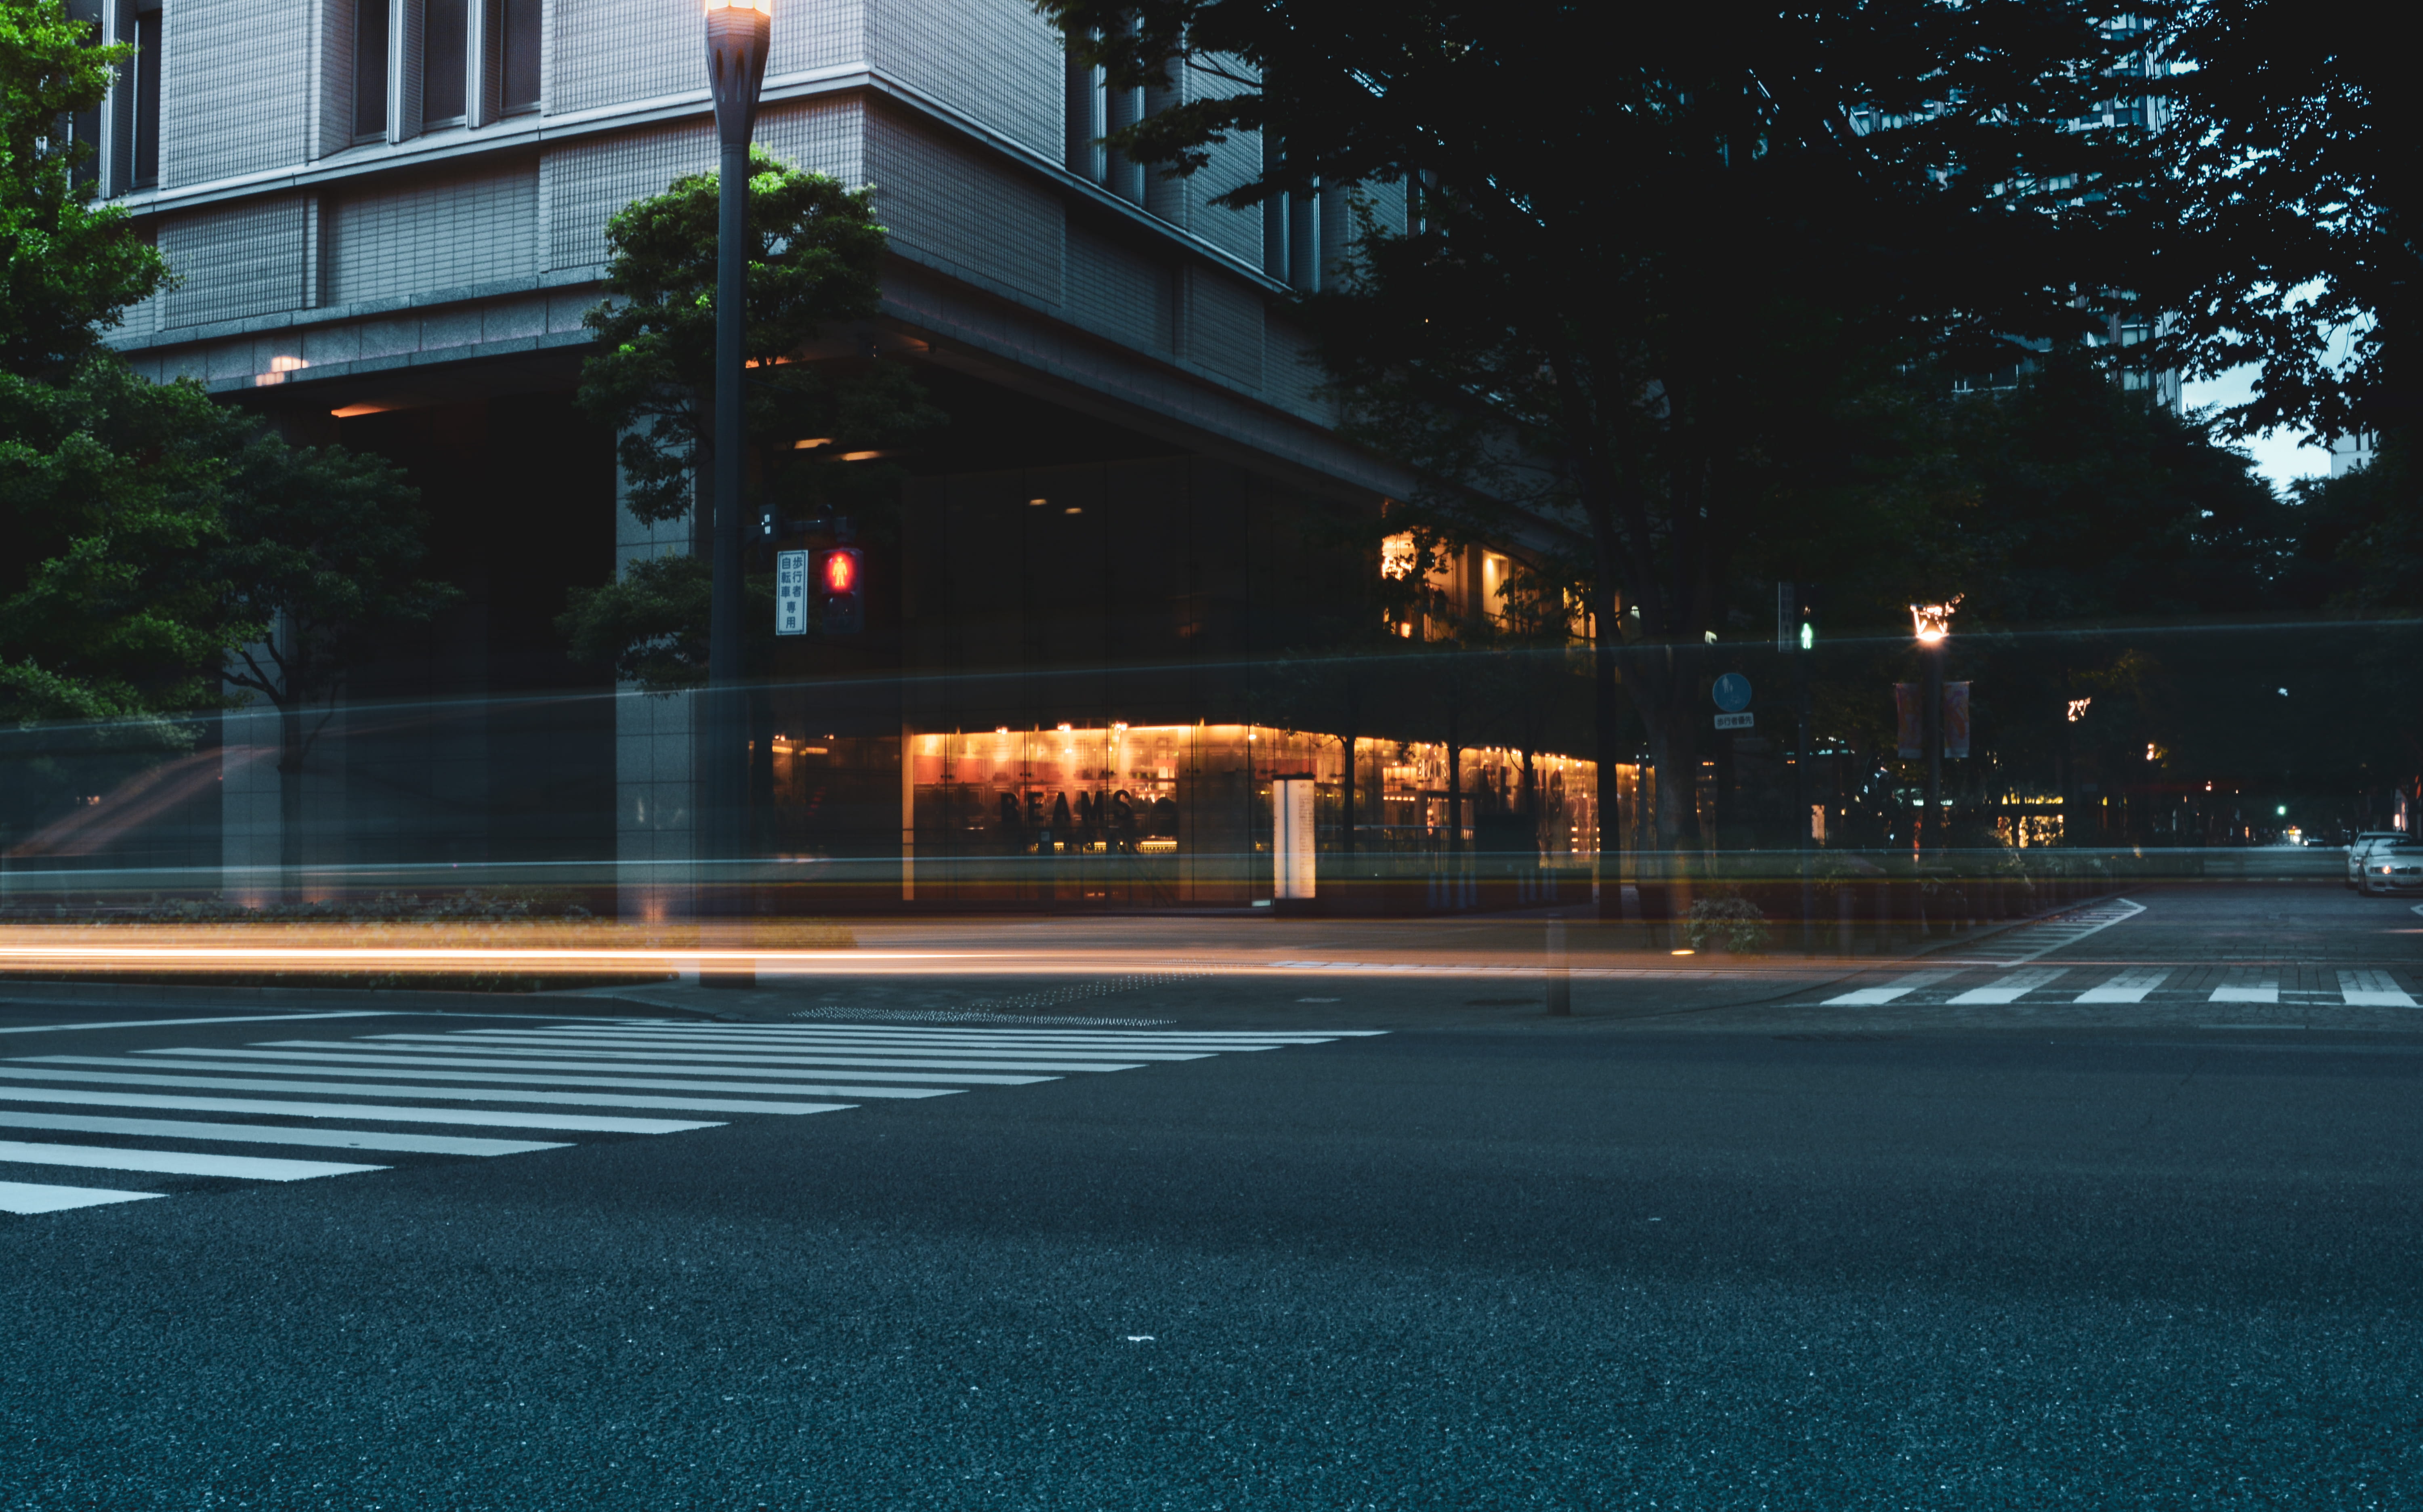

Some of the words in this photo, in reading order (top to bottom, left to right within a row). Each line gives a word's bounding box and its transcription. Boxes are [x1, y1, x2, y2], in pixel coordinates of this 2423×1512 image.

[781, 557, 791, 598] 自転車
[792, 556, 802, 598] 歩行者
[786, 601, 796, 628] 専用
[1717, 715, 1752, 727] 歩行者優先
[1001, 790, 1132, 821] BEAMS
